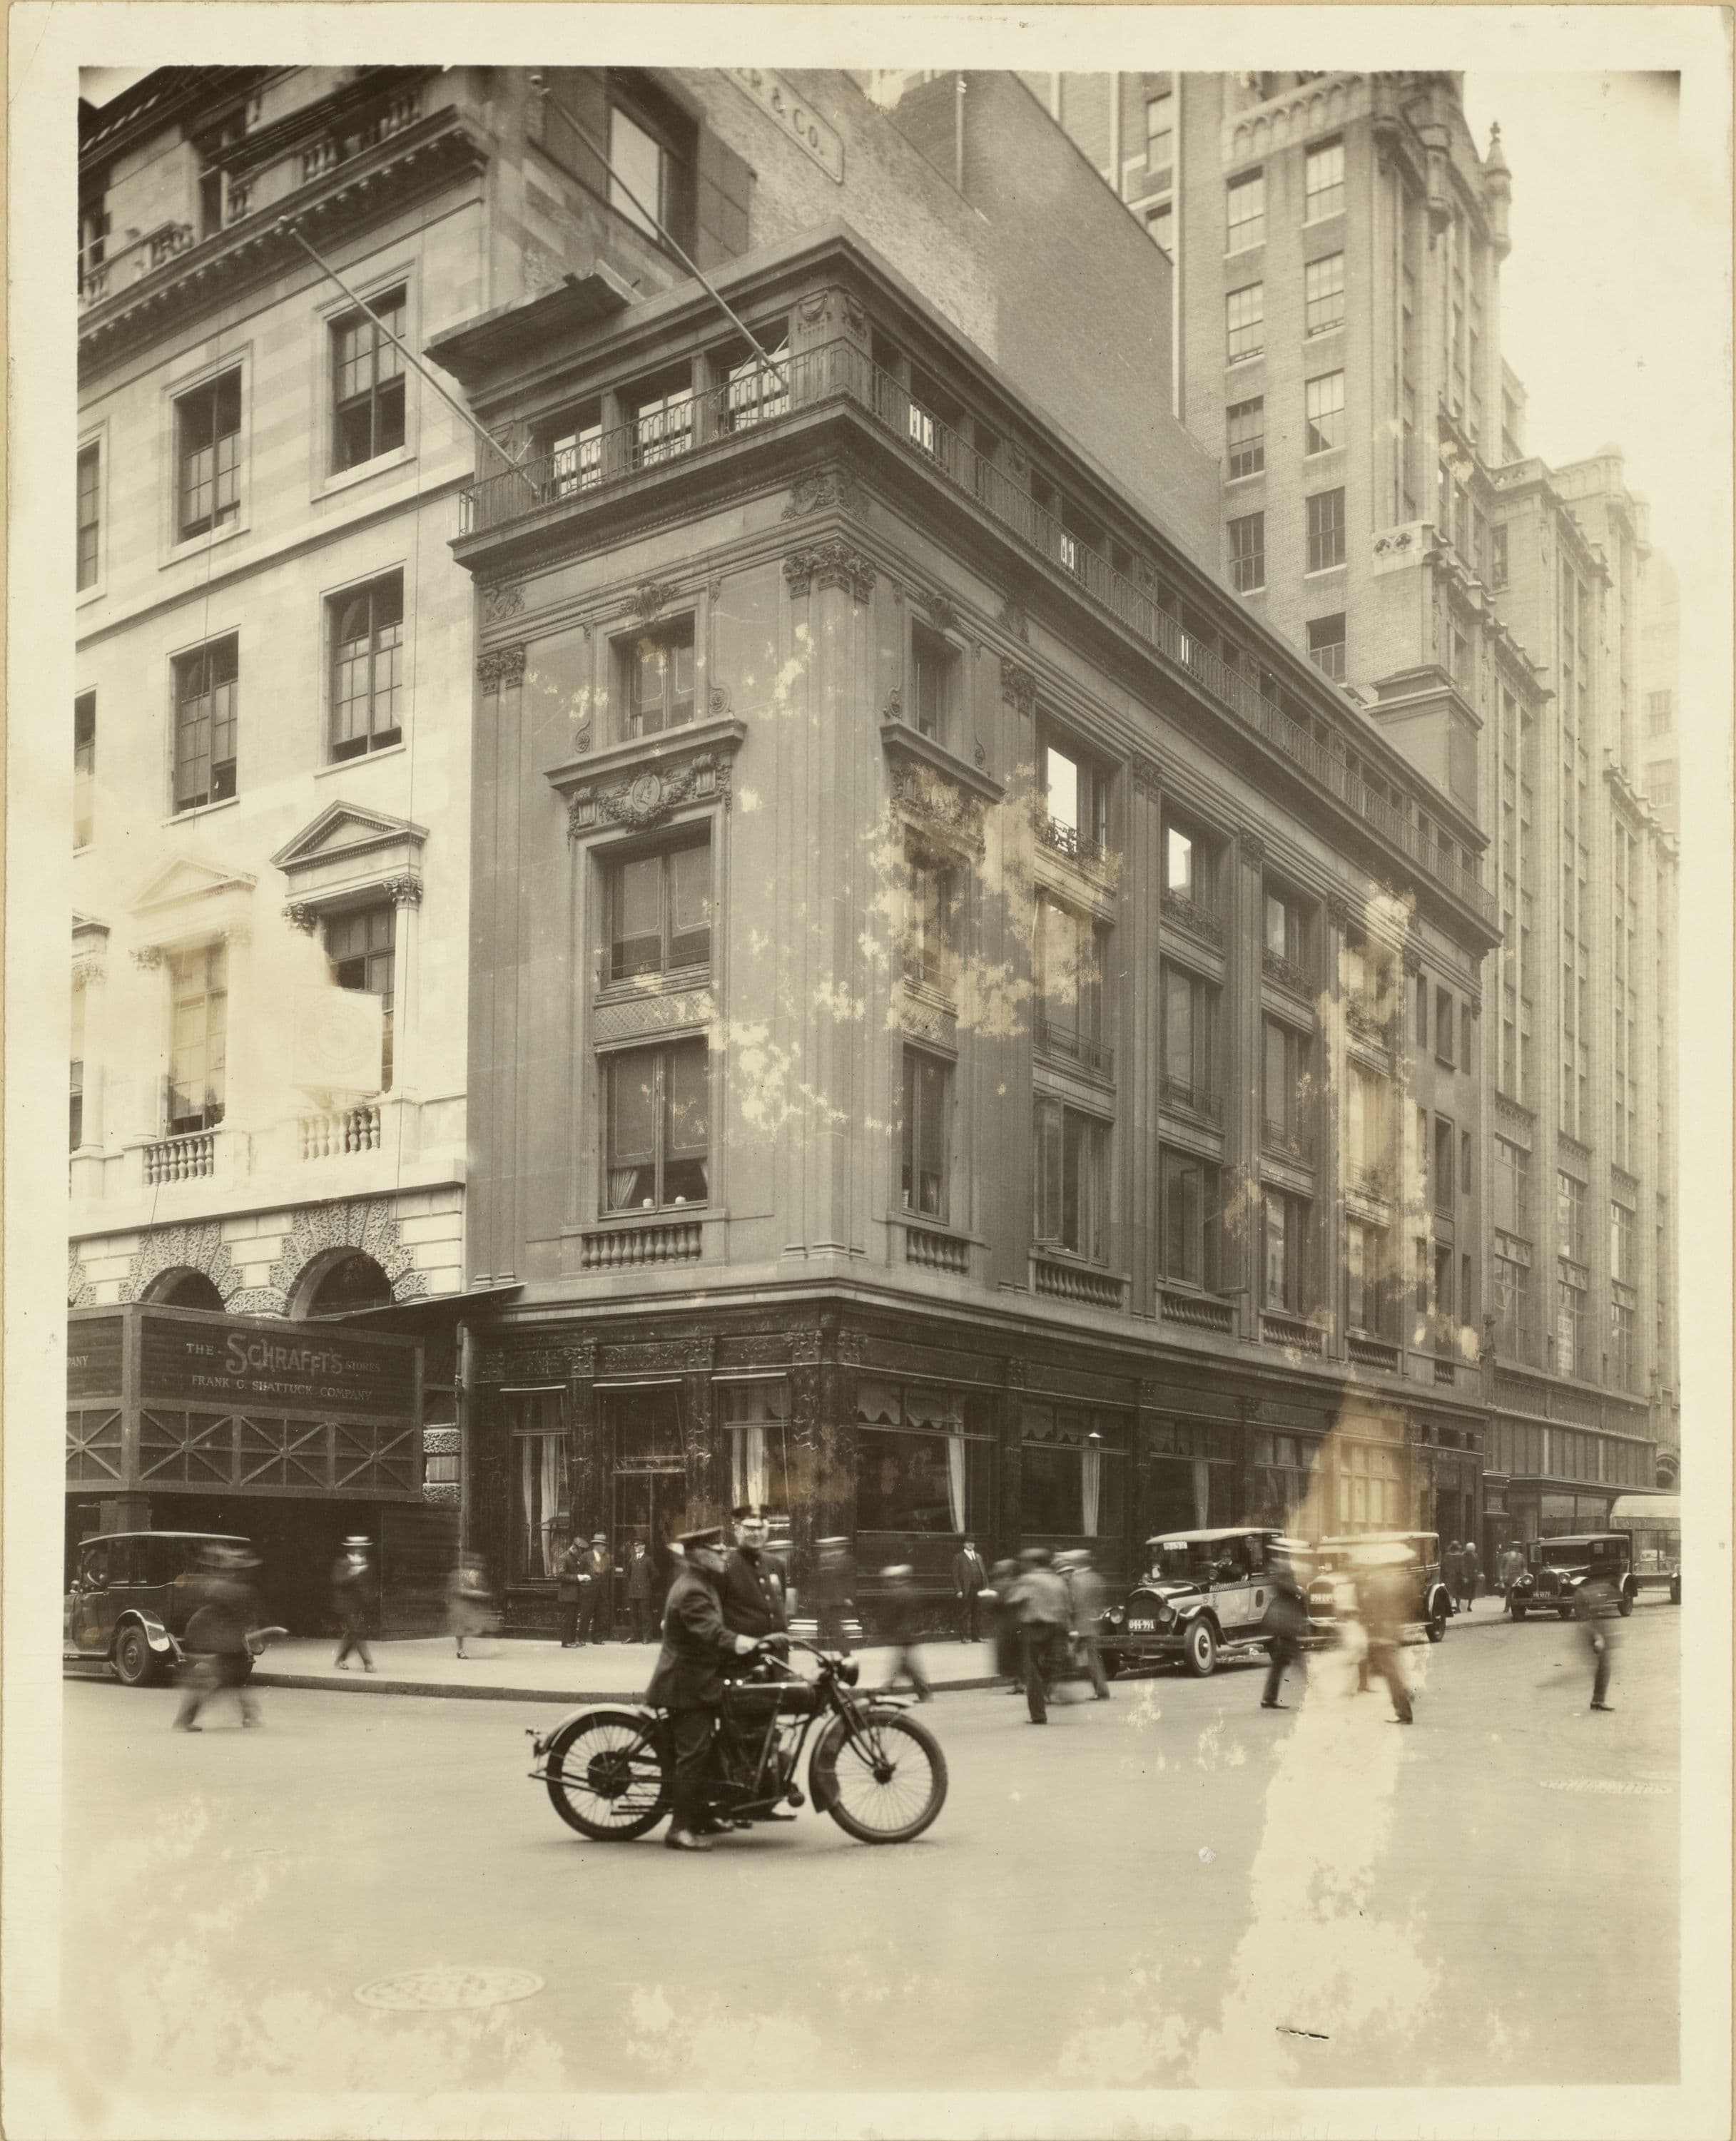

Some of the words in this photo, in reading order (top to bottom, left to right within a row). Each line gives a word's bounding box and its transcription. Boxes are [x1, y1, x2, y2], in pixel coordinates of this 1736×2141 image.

[771, 86, 786, 119] &
[186, 1343, 214, 1356] THE
[192, 1375, 229, 1388] FRANK
[252, 1380, 313, 1395] SHATTUCK
[320, 1387, 372, 1400] COMPANY
